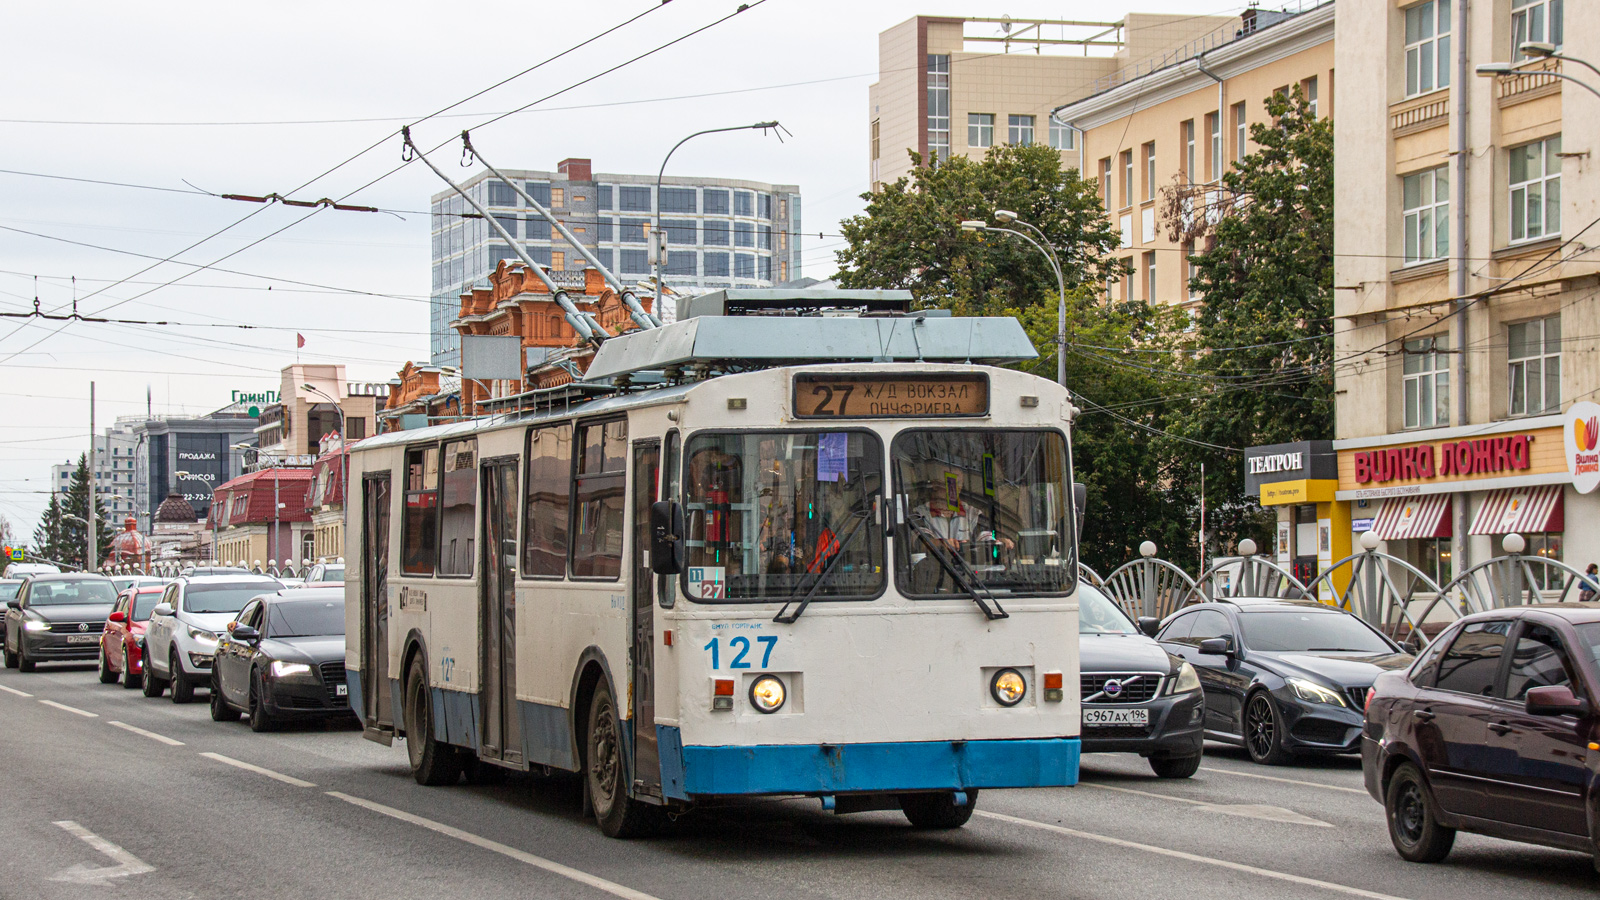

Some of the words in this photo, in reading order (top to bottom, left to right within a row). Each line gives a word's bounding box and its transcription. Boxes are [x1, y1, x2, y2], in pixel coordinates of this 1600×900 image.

[812, 384, 854, 416] 27
[864, 384, 897, 398] Ж/Д
[907, 384, 968, 398] ВОКЗАЛ
[179, 452, 216, 460] ПРОДАЖА
[1248, 451, 1303, 475] ТЕАТРОН
[179, 473, 216, 481] ОФИСОВ
[181, 493, 214, 501] 22-73-7
[691, 569, 702, 581] 11
[703, 584, 723, 599] 27
[704, 635, 778, 670] 127
[441, 656, 455, 682] 127
[1130, 709, 1146, 719] 196
